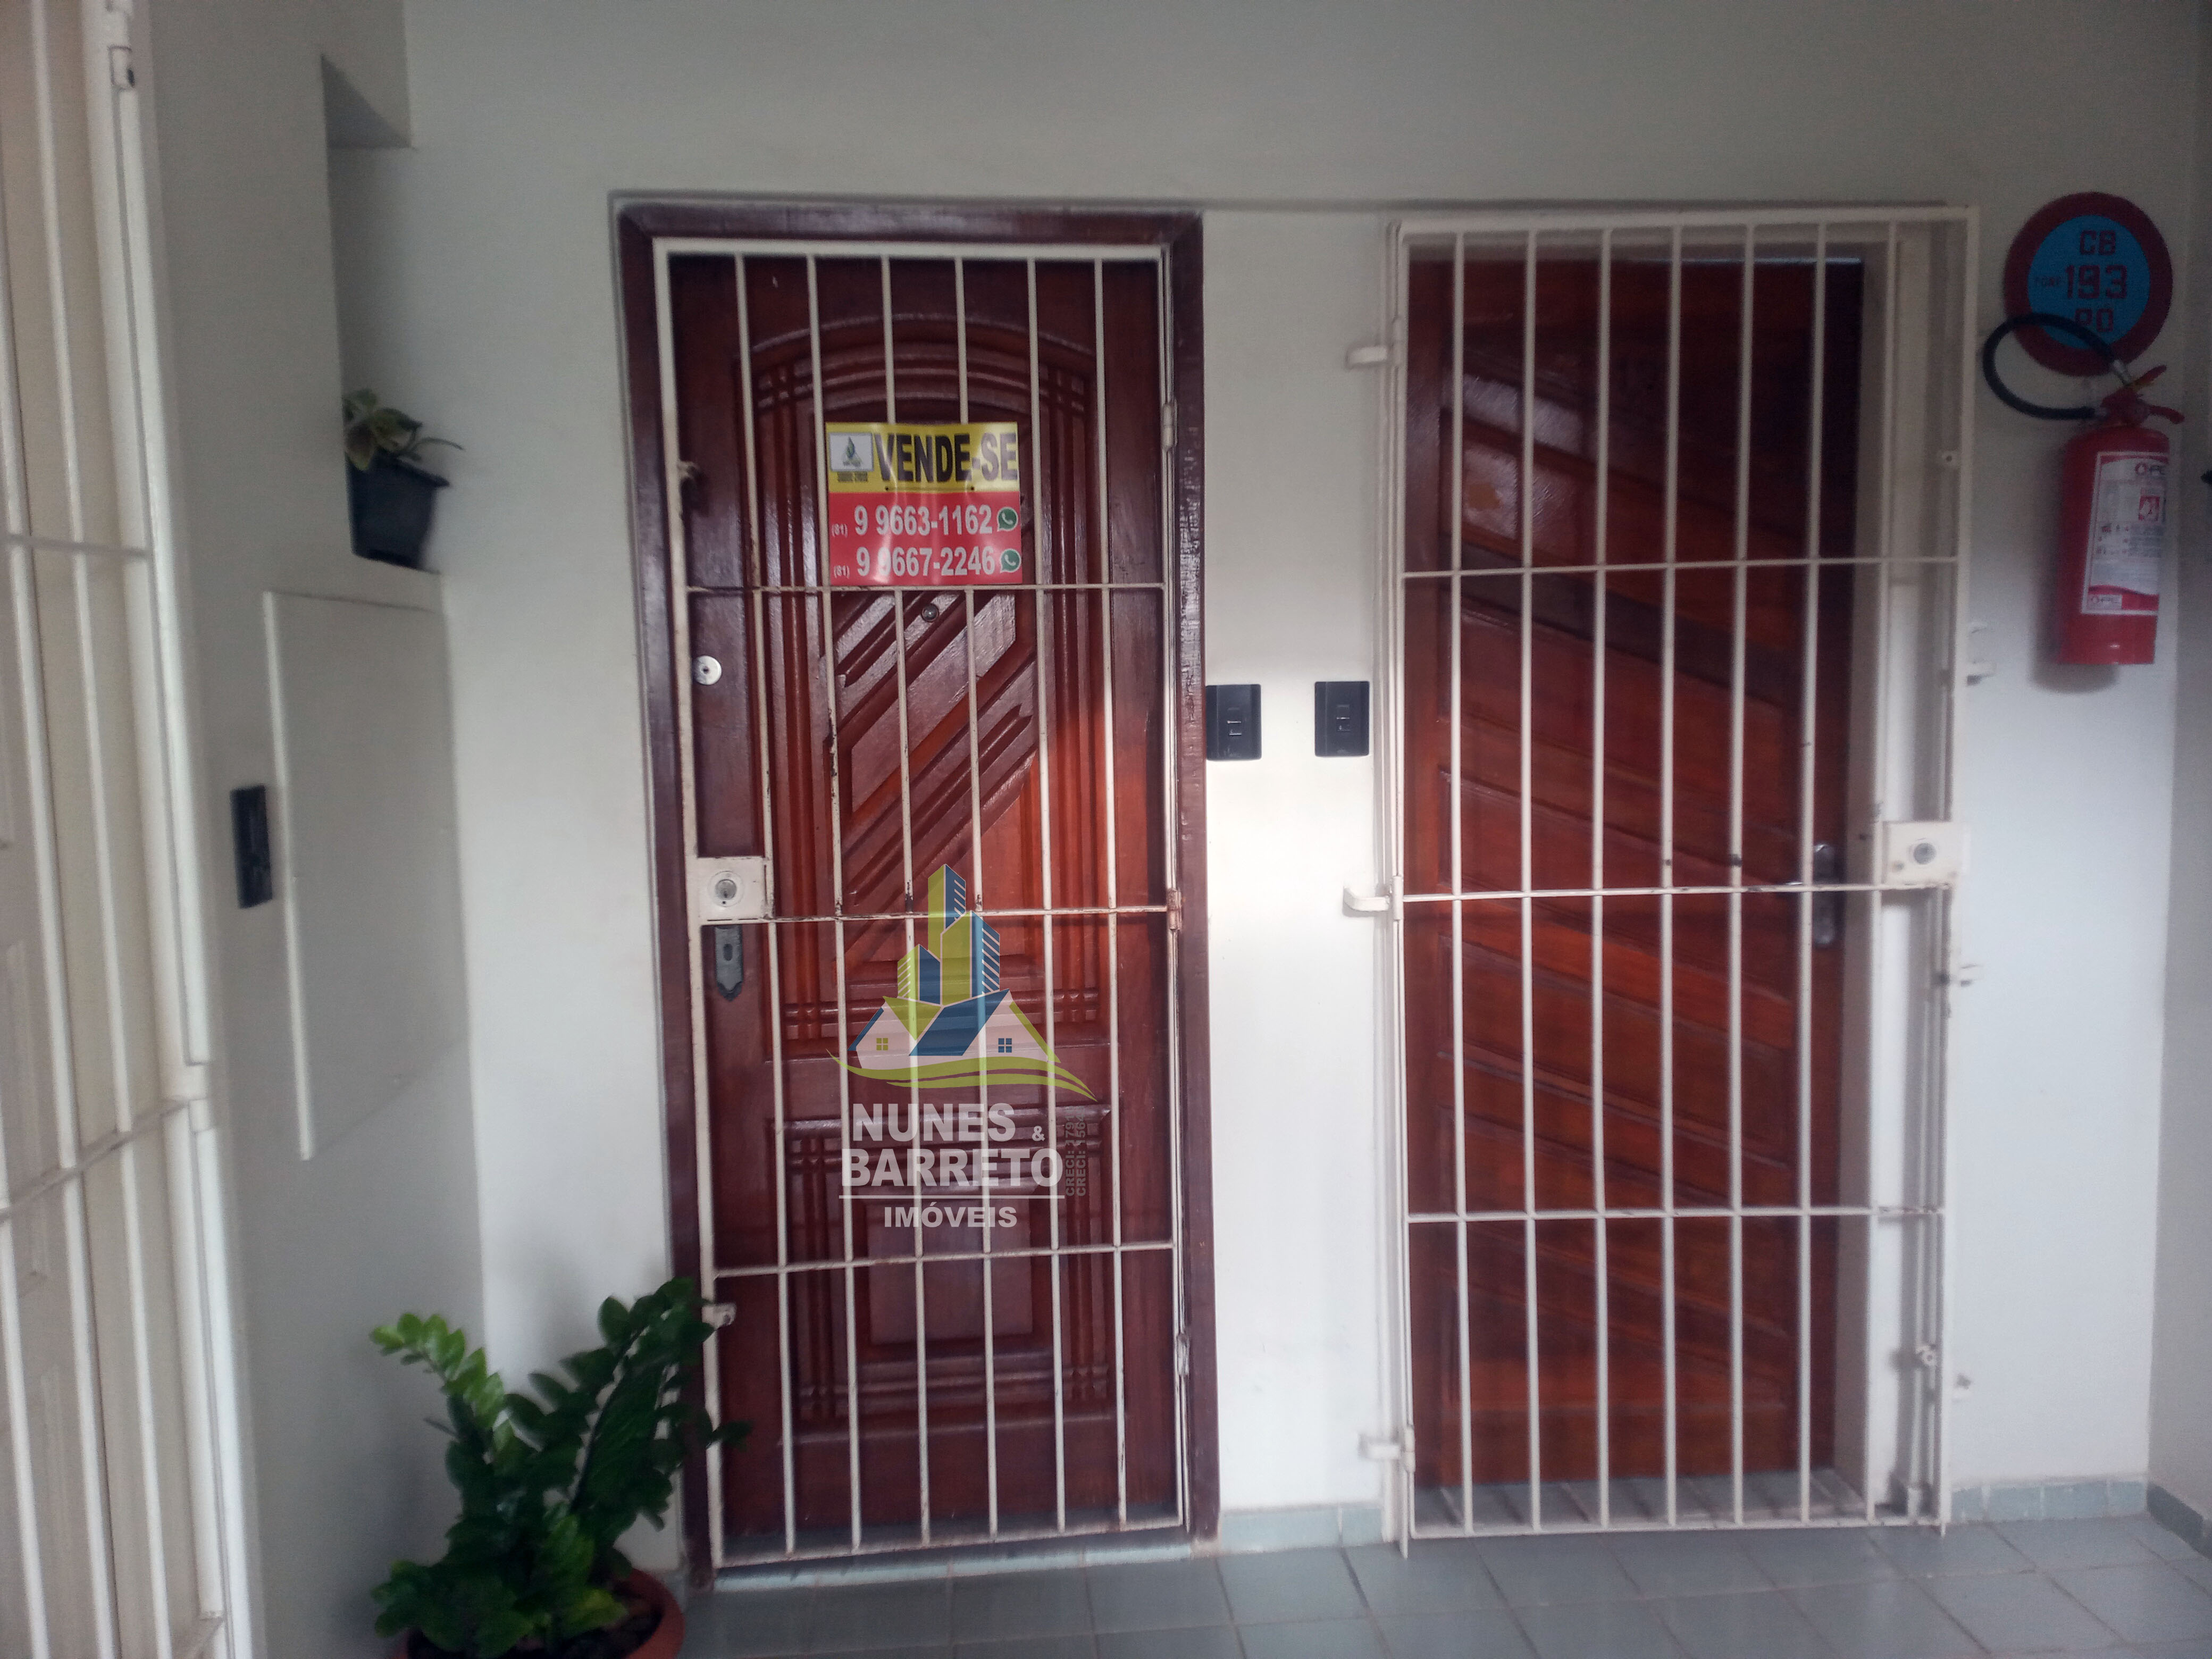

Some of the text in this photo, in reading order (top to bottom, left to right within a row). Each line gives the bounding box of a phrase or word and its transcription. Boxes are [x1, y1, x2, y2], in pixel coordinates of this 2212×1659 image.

[2080, 230, 2116, 256] CB
[2065, 265, 2127, 299] 193
[874, 432, 1018, 483] VENDE-SE
[832, 505, 993, 537] (81) 9 9663-1162
[834, 546, 995, 578] (81) 9 9667-2246
